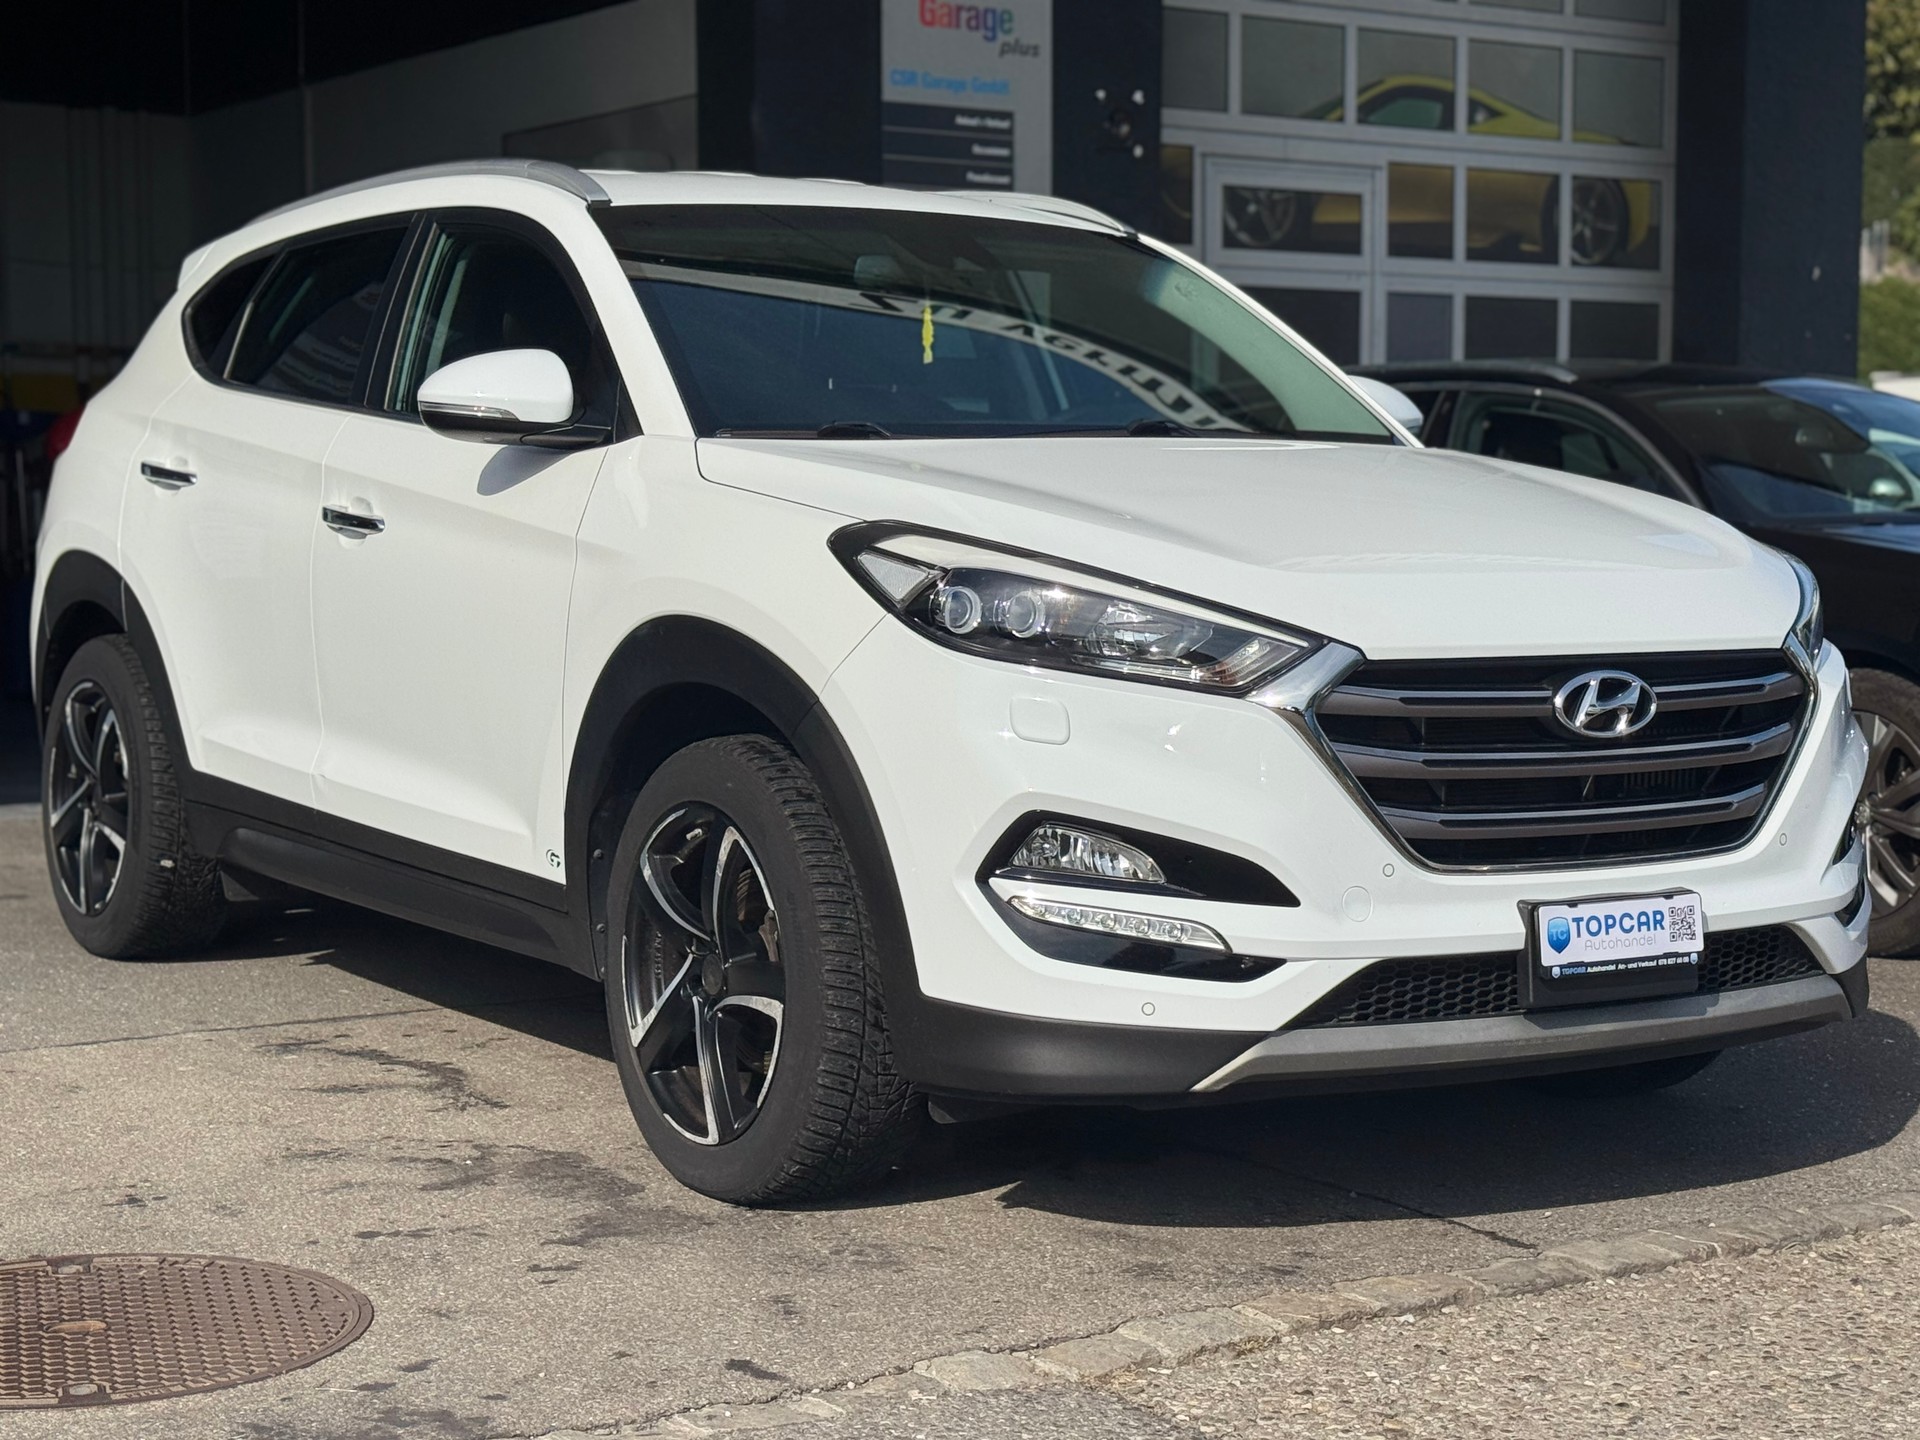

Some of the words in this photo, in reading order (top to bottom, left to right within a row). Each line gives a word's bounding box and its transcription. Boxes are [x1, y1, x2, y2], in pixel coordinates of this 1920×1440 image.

[918, 0, 1014, 42] Garage
[999, 38, 1041, 57] plus
[1571, 910, 1665, 938] TOPCAR
[1584, 934, 1657, 951] Autohandel
[1561, 966, 1586, 975] TOPCAR
[1586, 964, 1616, 973] Autohandel
